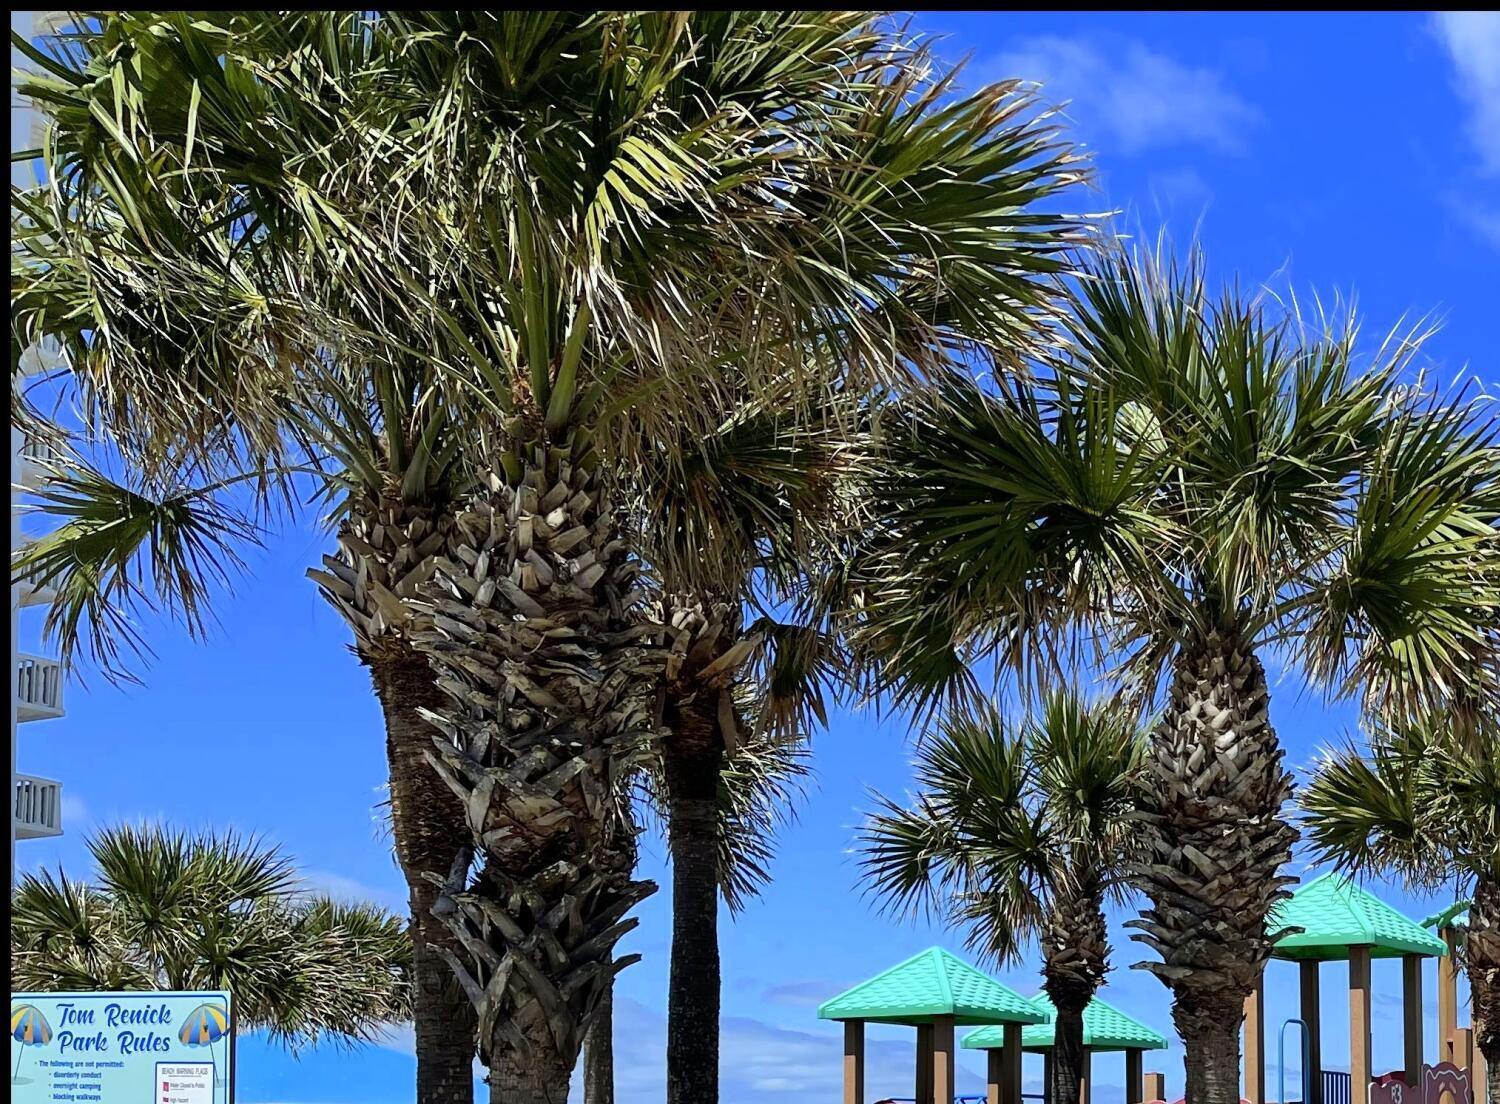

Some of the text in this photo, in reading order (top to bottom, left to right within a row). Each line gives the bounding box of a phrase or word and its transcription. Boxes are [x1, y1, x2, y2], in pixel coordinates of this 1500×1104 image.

[56, 1003, 172, 1027] Tom Renick
[57, 1030, 171, 1054] Park Rules
[50, 1060, 73, 1069] following
[80, 1083, 102, 1091] camping
[53, 1093, 74, 1102] blocking
